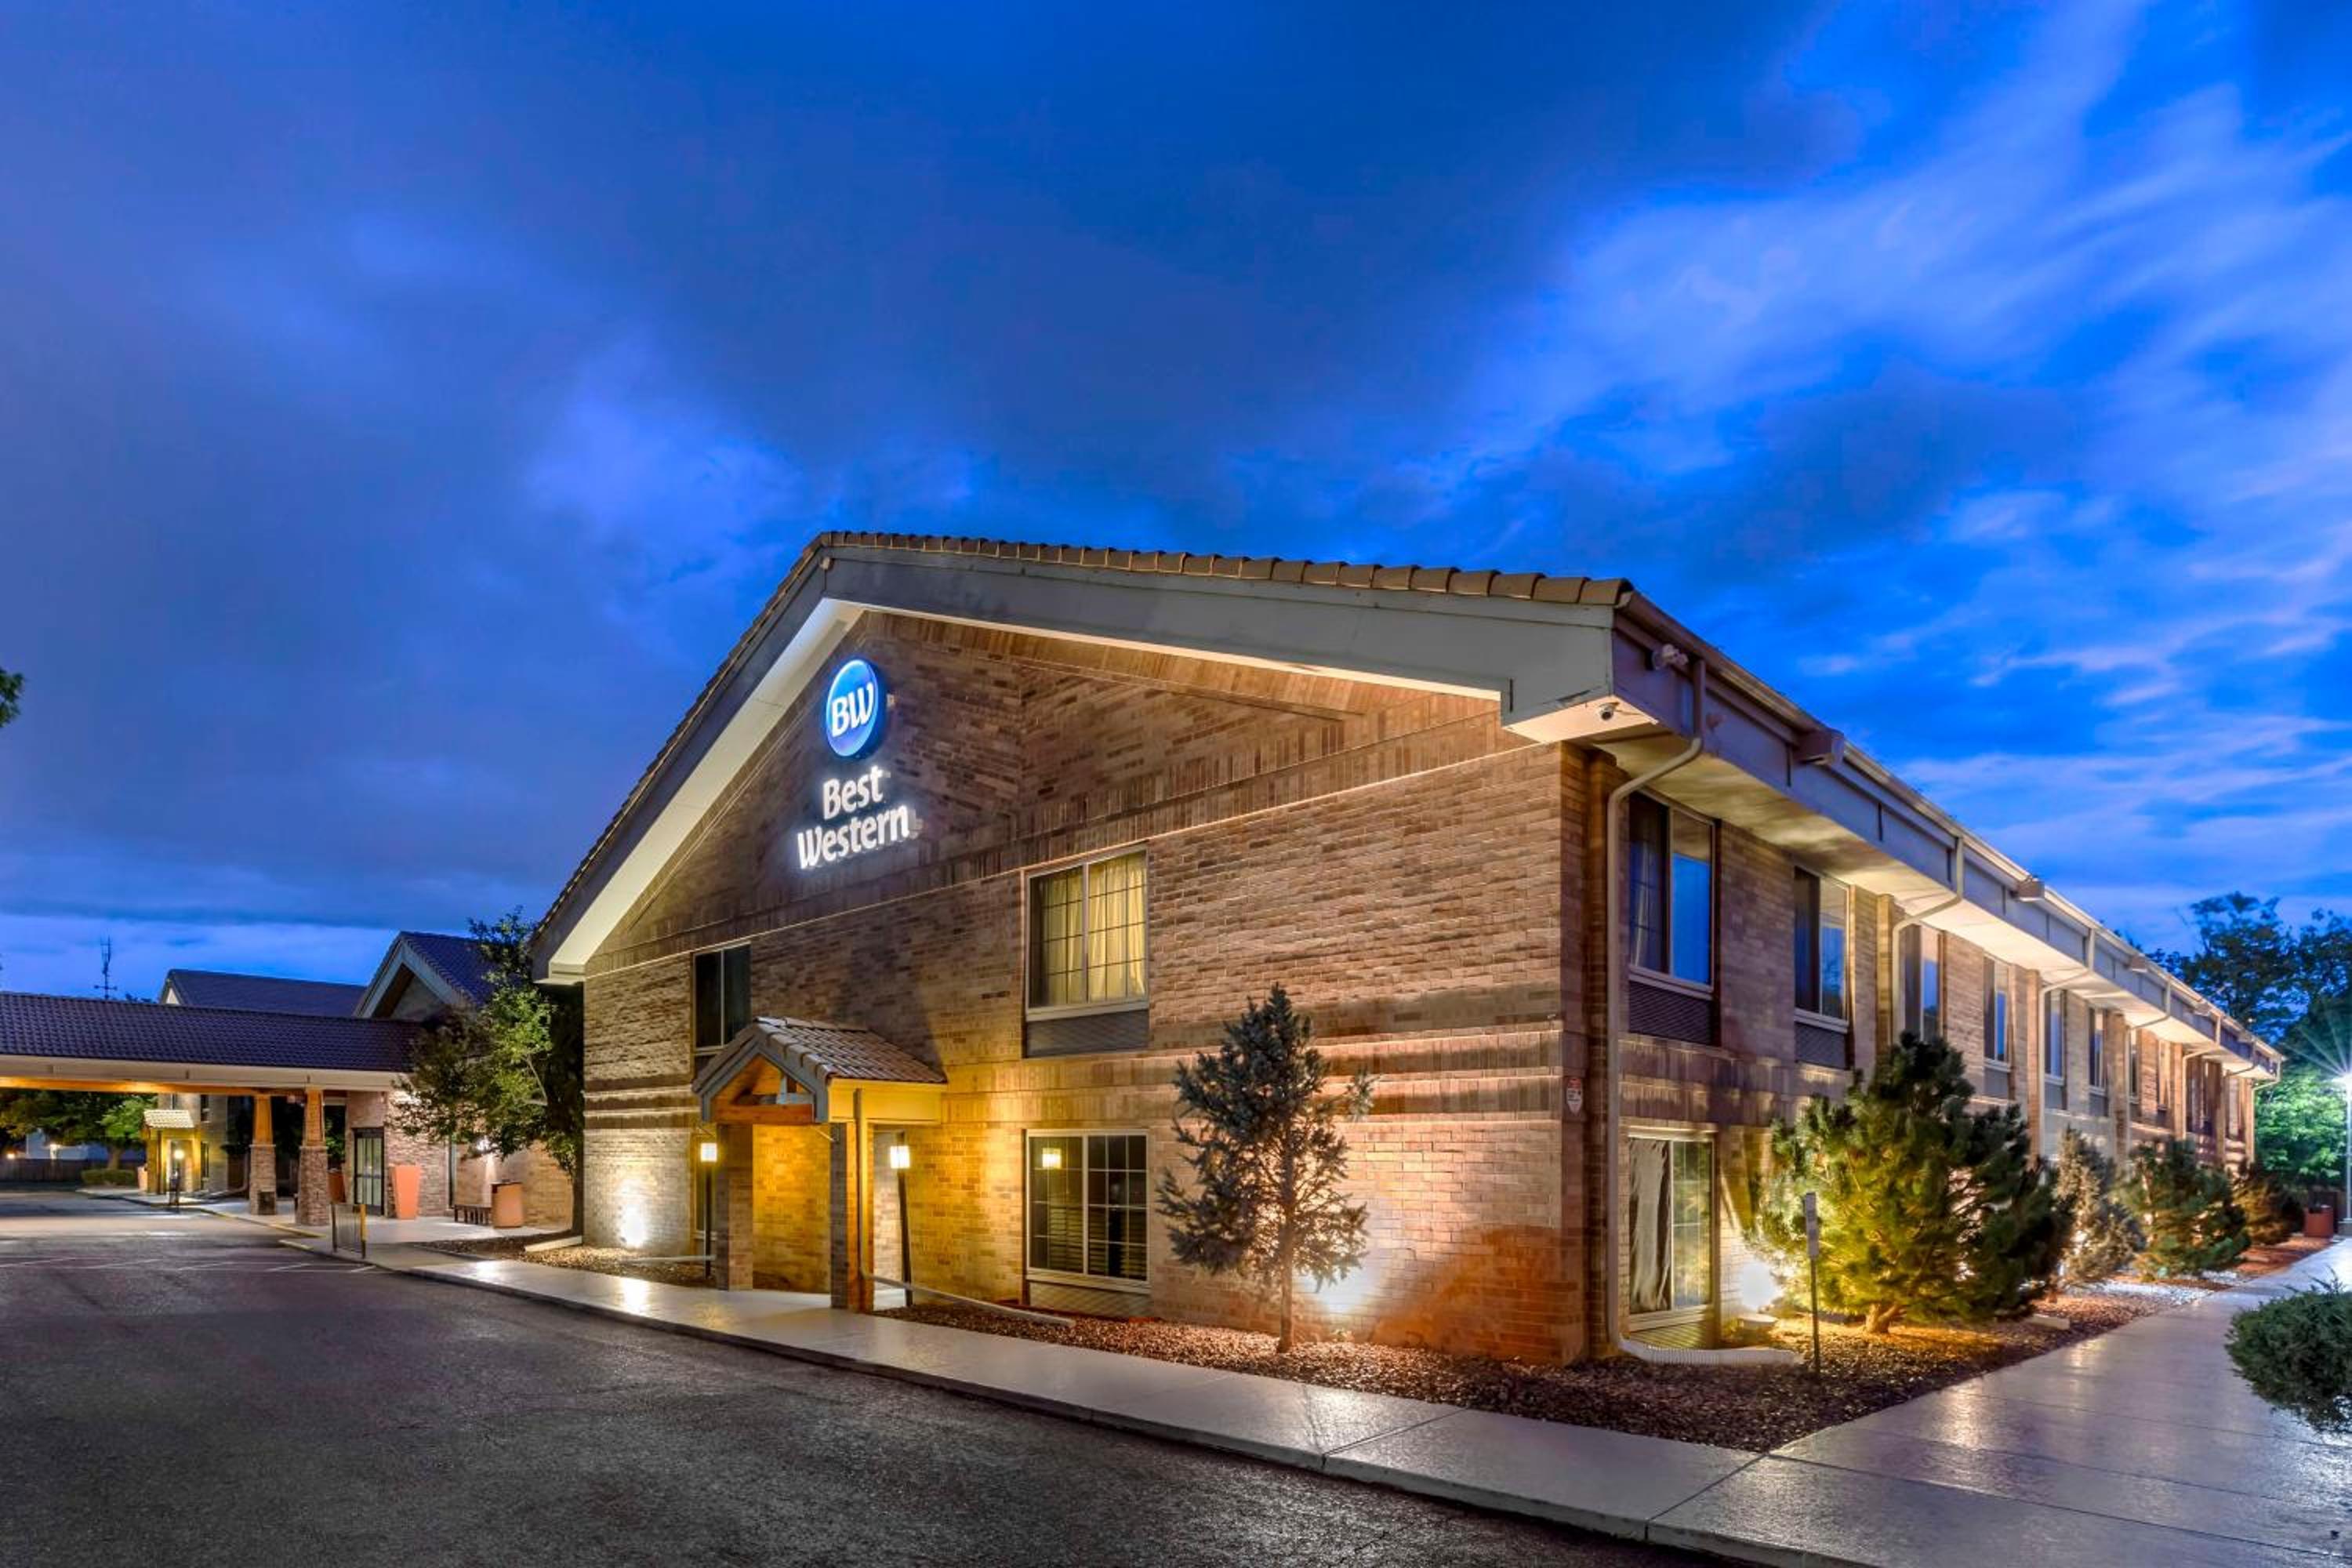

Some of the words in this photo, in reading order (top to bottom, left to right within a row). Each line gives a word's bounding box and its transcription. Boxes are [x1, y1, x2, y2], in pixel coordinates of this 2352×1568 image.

[831, 682, 874, 737] BW
[823, 765, 884, 820] Best
[797, 805, 910, 869] Western
